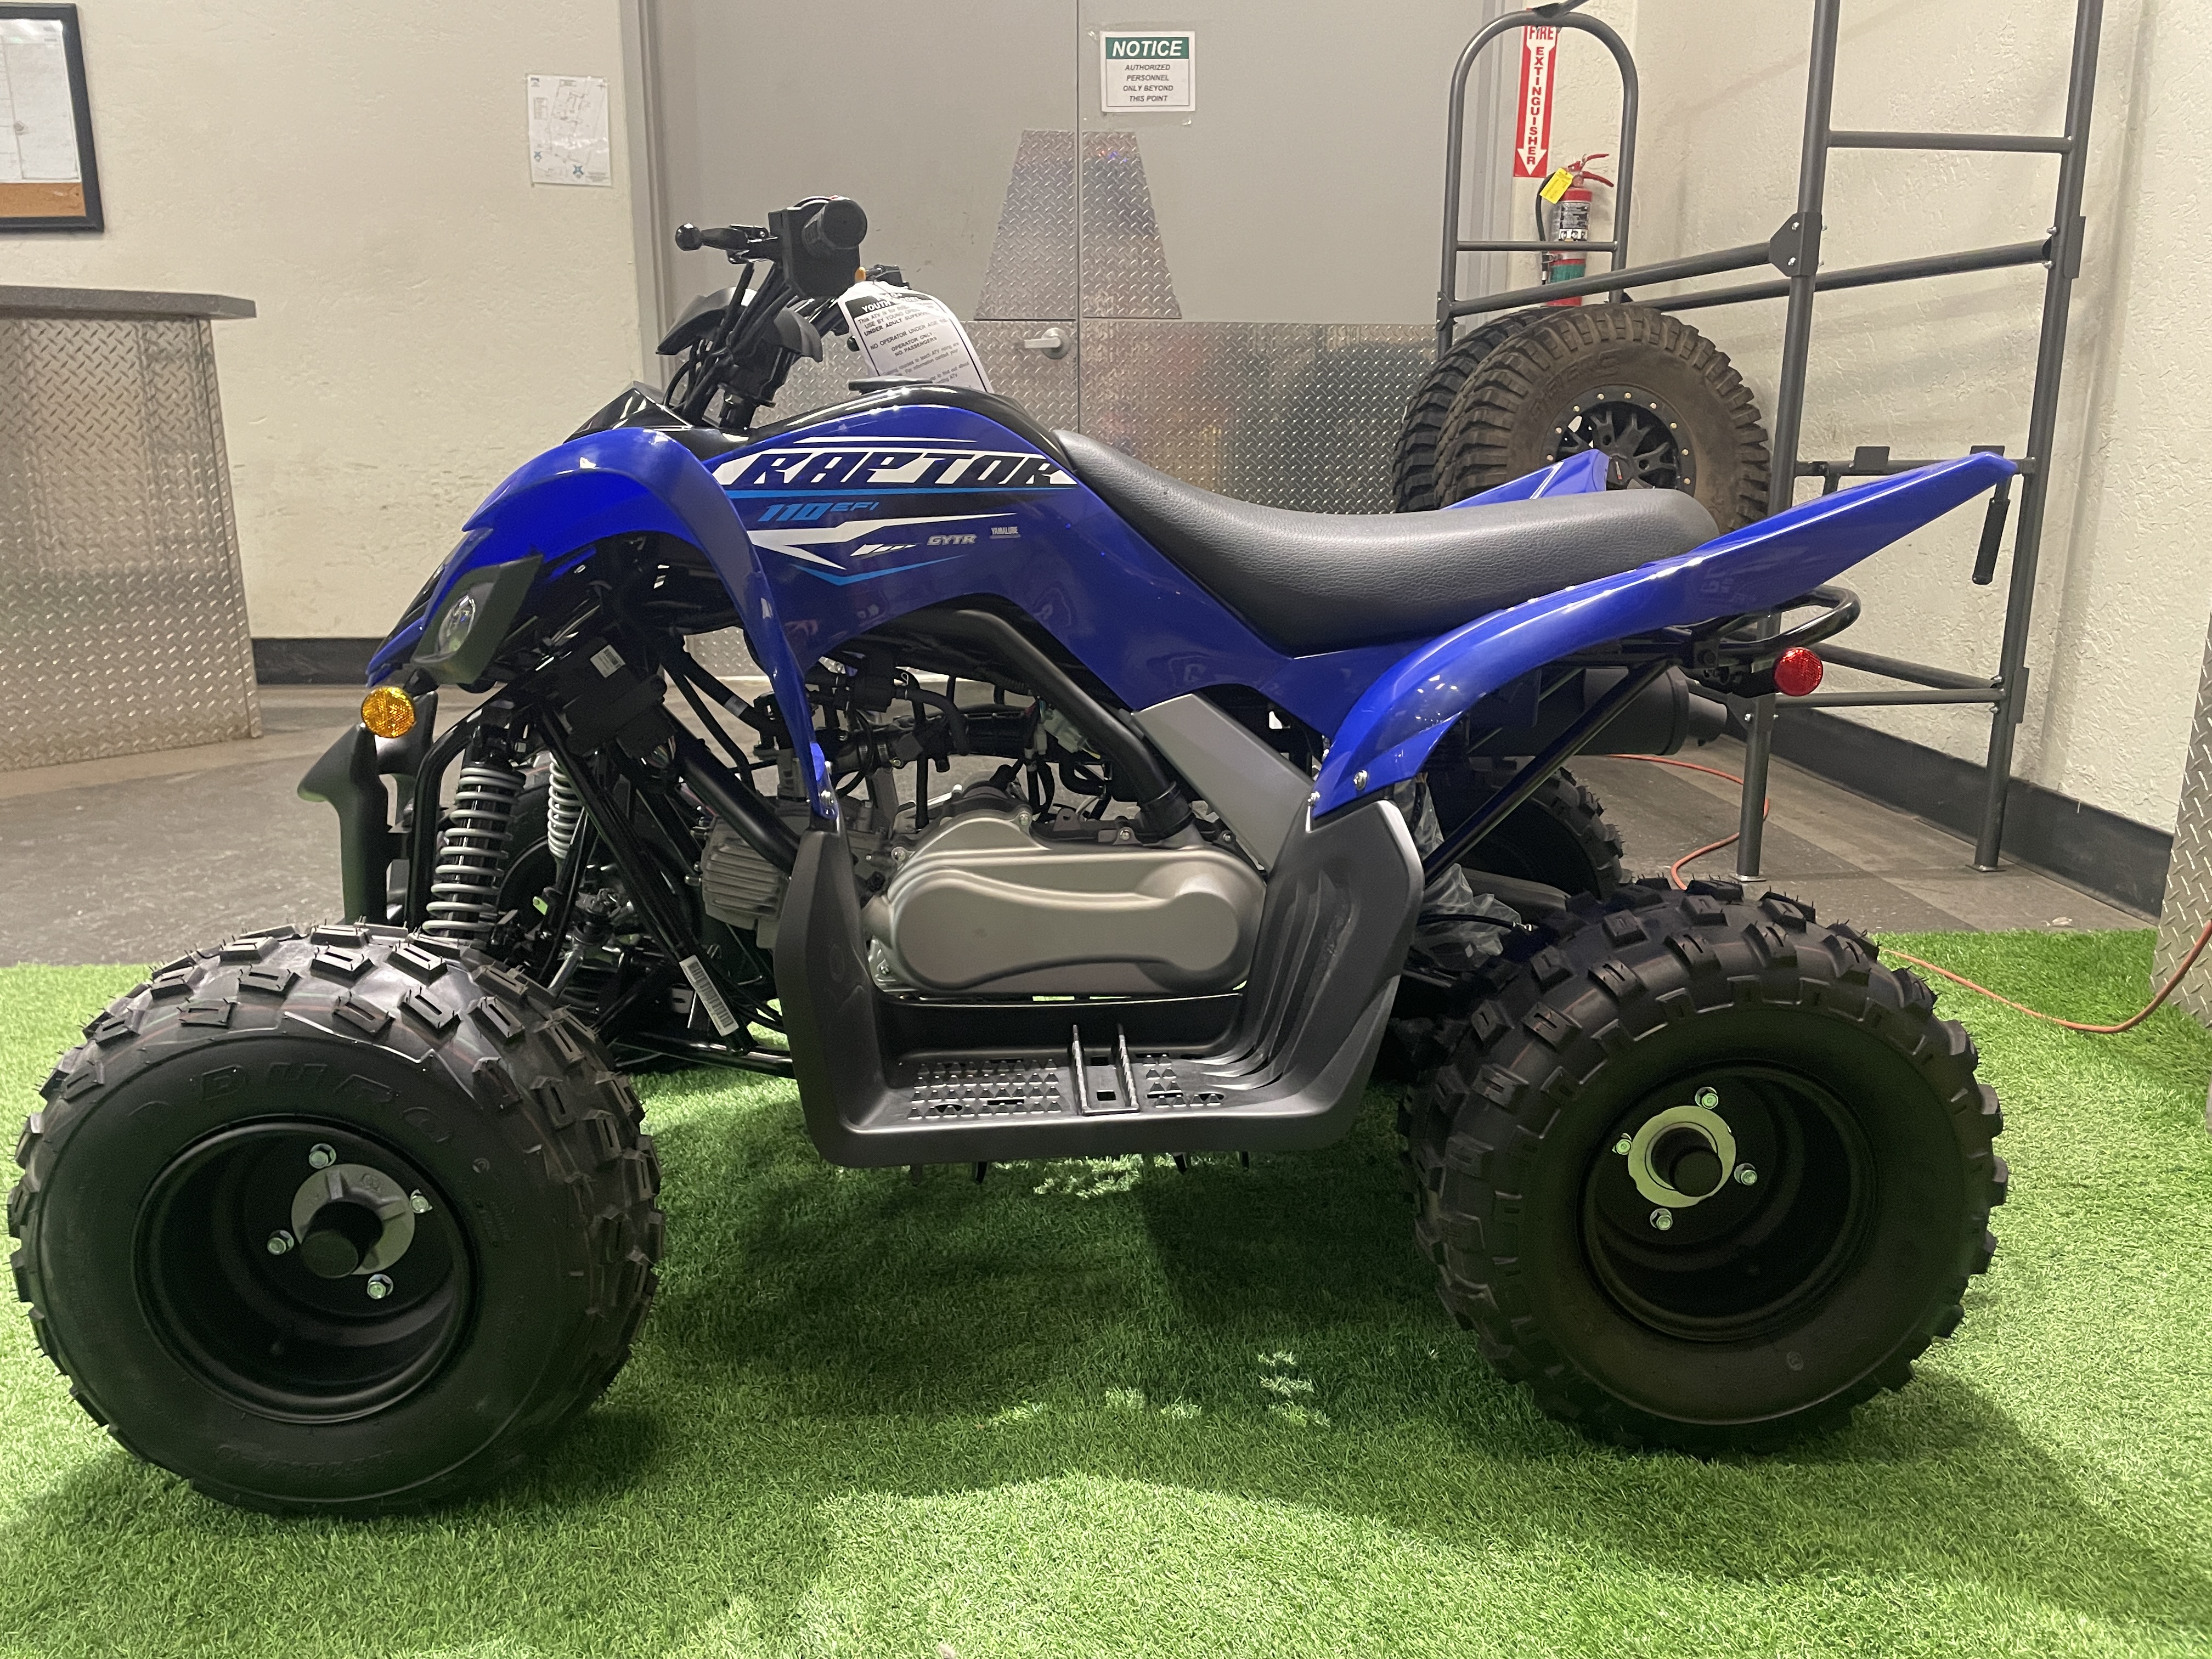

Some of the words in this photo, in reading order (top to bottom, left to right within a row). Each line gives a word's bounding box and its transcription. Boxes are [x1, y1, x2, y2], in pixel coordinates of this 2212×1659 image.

[1529, 25, 1554, 40] FIRE
[1112, 40, 1183, 57] NOTICE
[1526, 47, 1544, 165] EXTINGUISHER
[861, 300, 891, 313] YOUTH
[864, 321, 876, 329] USE
[885, 311, 904, 320] YOUNG
[864, 325, 884, 336] UNDER
[885, 318, 902, 328] ADULT
[879, 331, 907, 346] OPERATOR
[908, 324, 926, 334] UNDER
[891, 337, 918, 352] OPERATOR
[919, 331, 933, 340] ONLY
[904, 336, 937, 352] PASSENGERS
[732, 452, 1060, 485] RAPTOR
[758, 502, 831, 522] 110
[830, 501, 879, 512] EFI
[927, 534, 977, 546] GYTR
